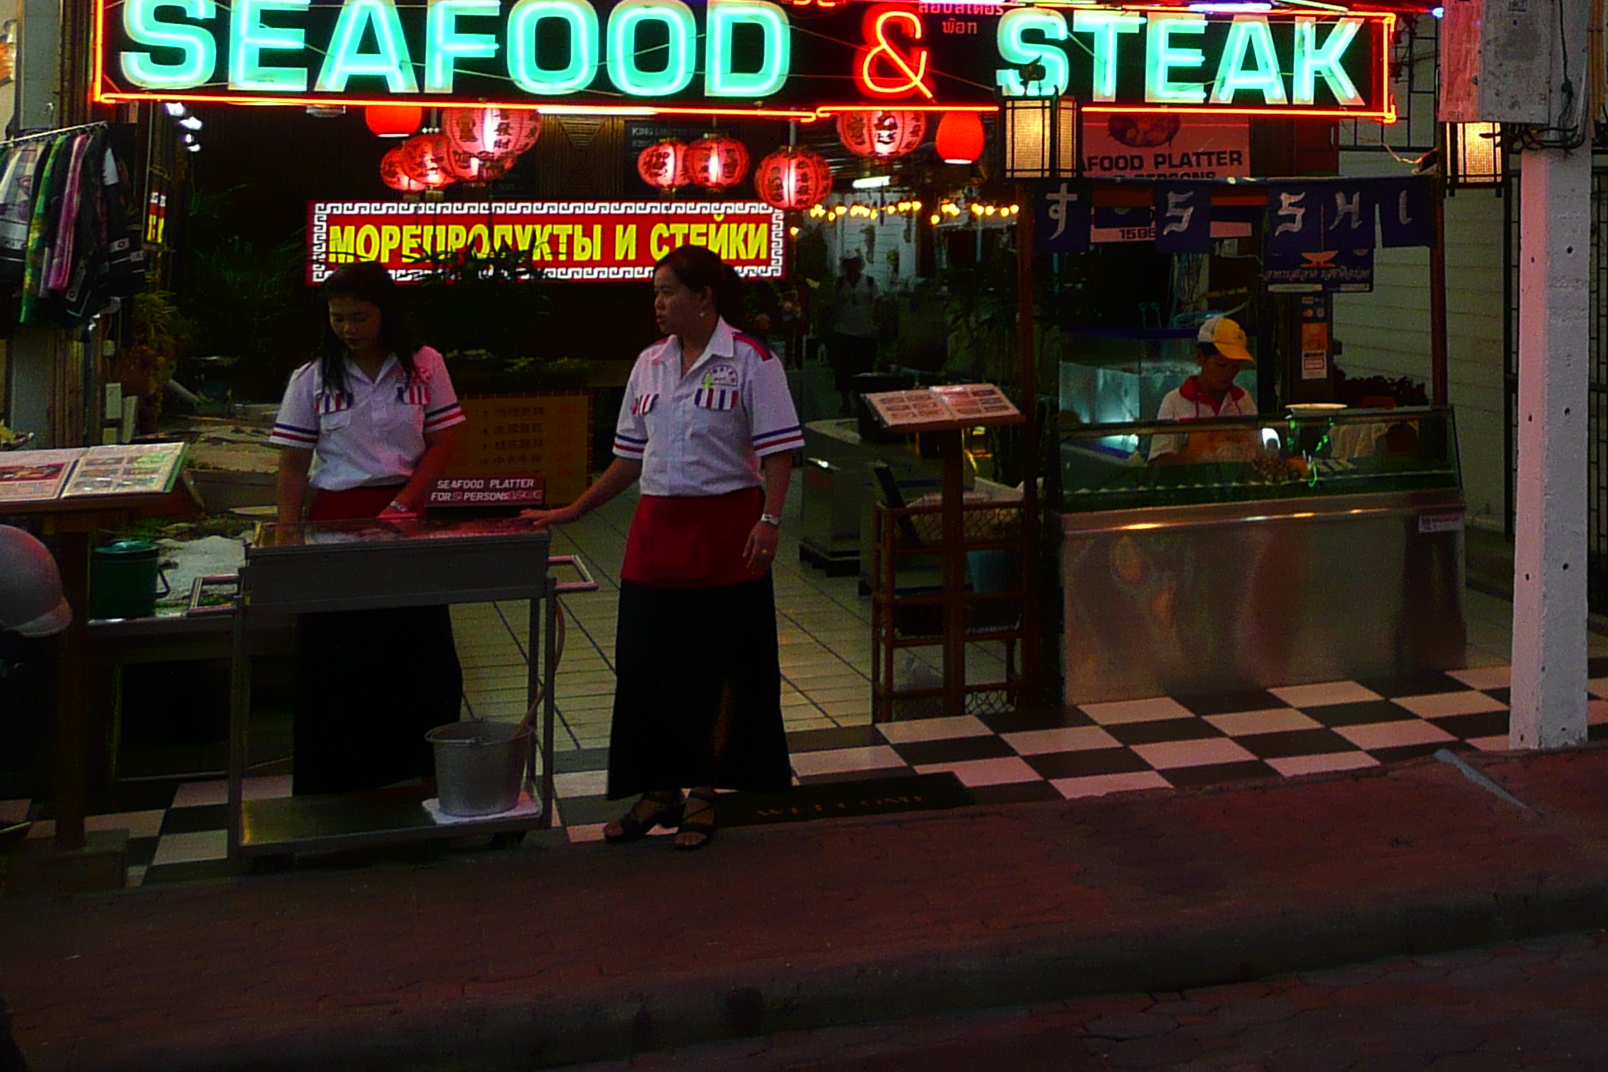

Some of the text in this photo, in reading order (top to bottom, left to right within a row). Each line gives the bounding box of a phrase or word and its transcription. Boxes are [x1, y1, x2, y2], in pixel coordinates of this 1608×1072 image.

[853, 1, 934, 104] &
[995, 5, 1367, 106] STEAK
[1153, 149, 1244, 170] PLATTER
[328, 213, 769, 264] МОРЕПРОДУКТЫ И СТЕЙКИ
[436, 478, 535, 489] SEAFOOD PLATTER
[430, 491, 451, 501] FOR
[463, 490, 508, 502] PERSONS
